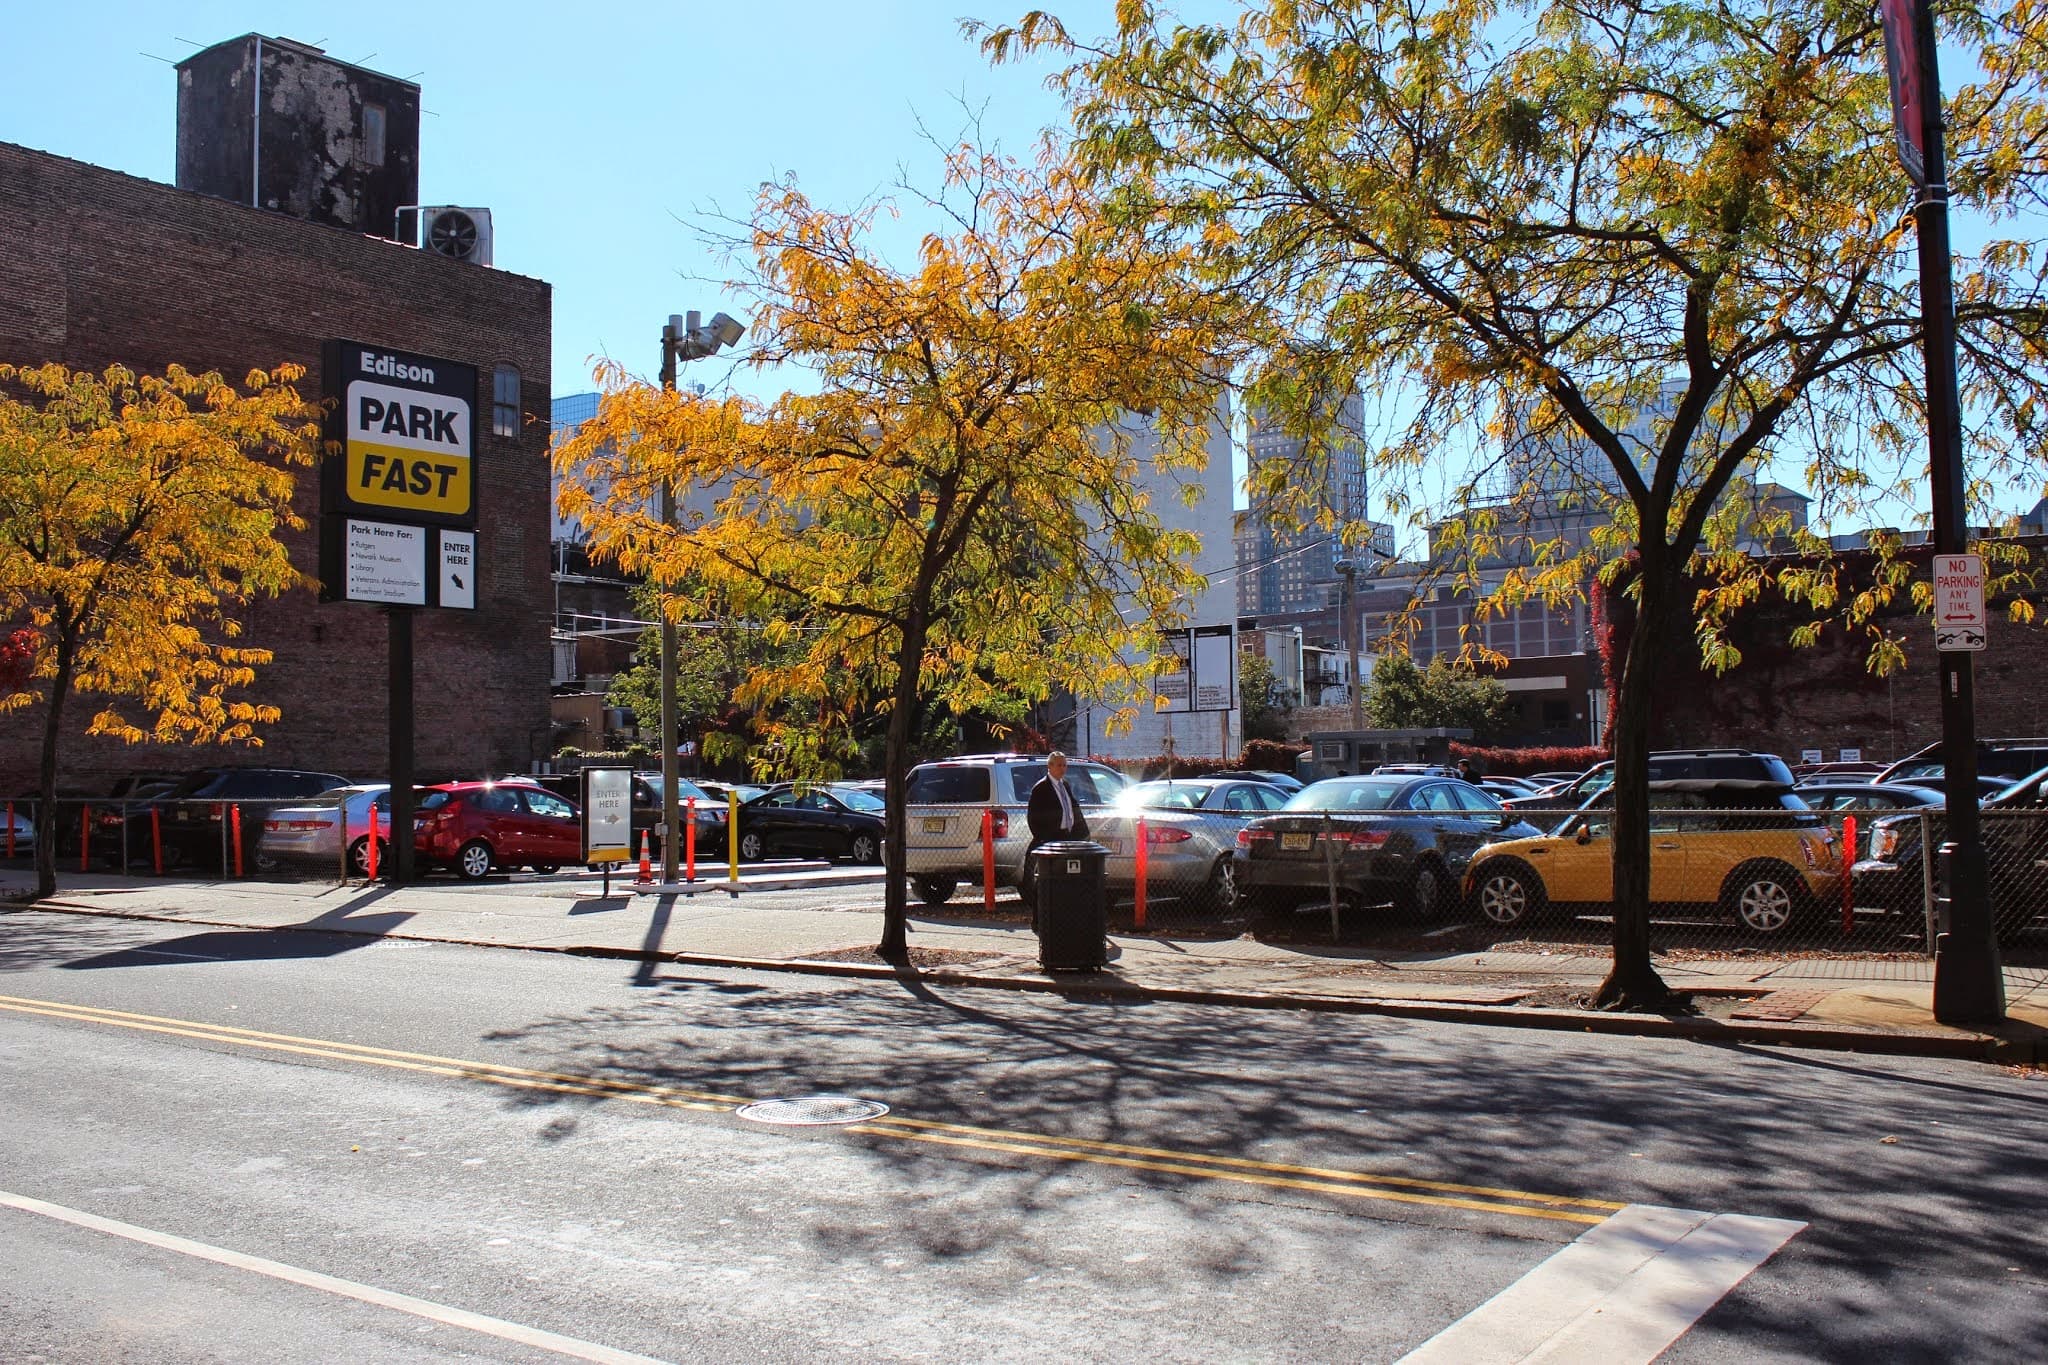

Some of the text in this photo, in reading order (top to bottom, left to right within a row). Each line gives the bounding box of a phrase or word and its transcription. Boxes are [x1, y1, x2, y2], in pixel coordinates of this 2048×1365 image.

[361, 351, 434, 384] Edison
[360, 396, 460, 445] PARK
[360, 454, 458, 498] FAST
[351, 524, 413, 539] Park Here For:
[355, 541, 376, 550] Rutgers
[444, 542, 471, 553] ENTER
[355, 552, 377, 561] Newark
[447, 555, 469, 565] HERE
[355, 563, 375, 573] Library
[1949, 560, 1967, 573] NO
[1937, 575, 1980, 588] PARKING
[1950, 590, 1968, 599] ANY
[1949, 602, 1971, 612] TIME
[596, 790, 621, 798] ENTER
[598, 800, 620, 809] HERE
